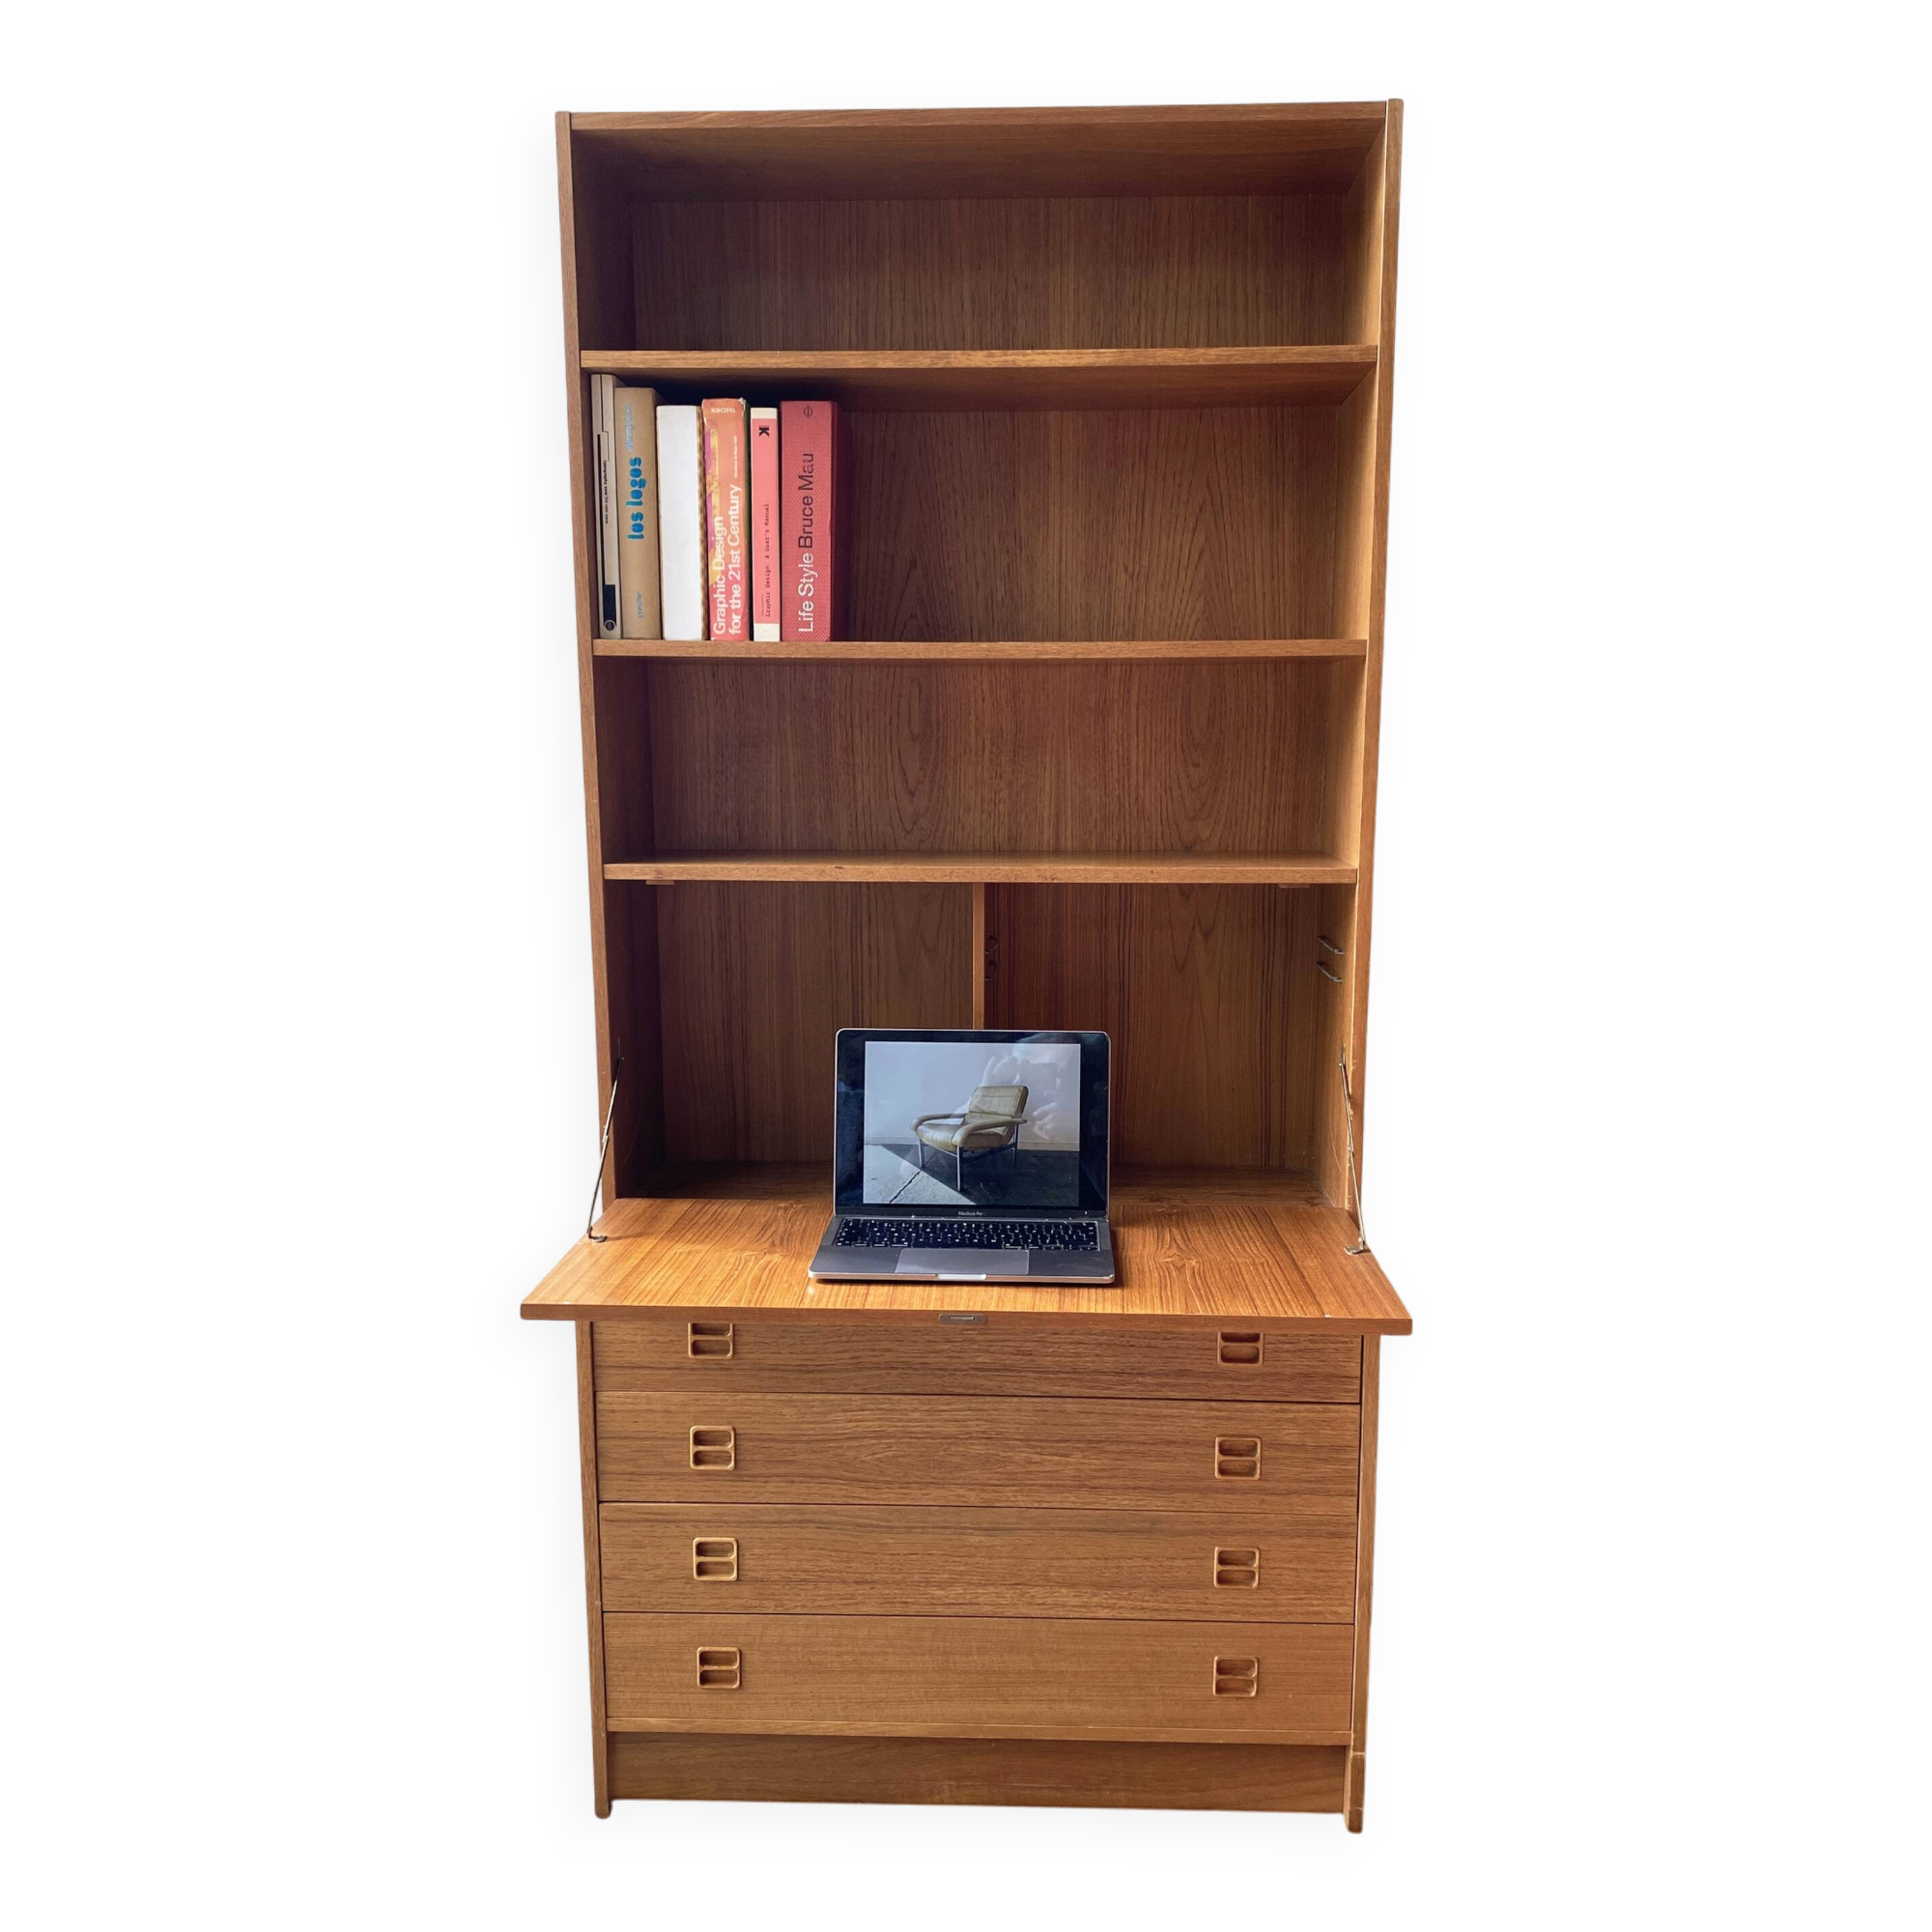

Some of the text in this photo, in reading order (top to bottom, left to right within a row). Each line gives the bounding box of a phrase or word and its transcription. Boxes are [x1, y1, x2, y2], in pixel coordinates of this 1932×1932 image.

[758, 426, 770, 437] K
[625, 457, 647, 506] logos
[626, 512, 644, 539] los
[727, 484, 742, 635] for the 21st Century
[798, 453, 818, 633] Life Style Bruce Mau
[713, 516, 728, 635] Graphic Design
